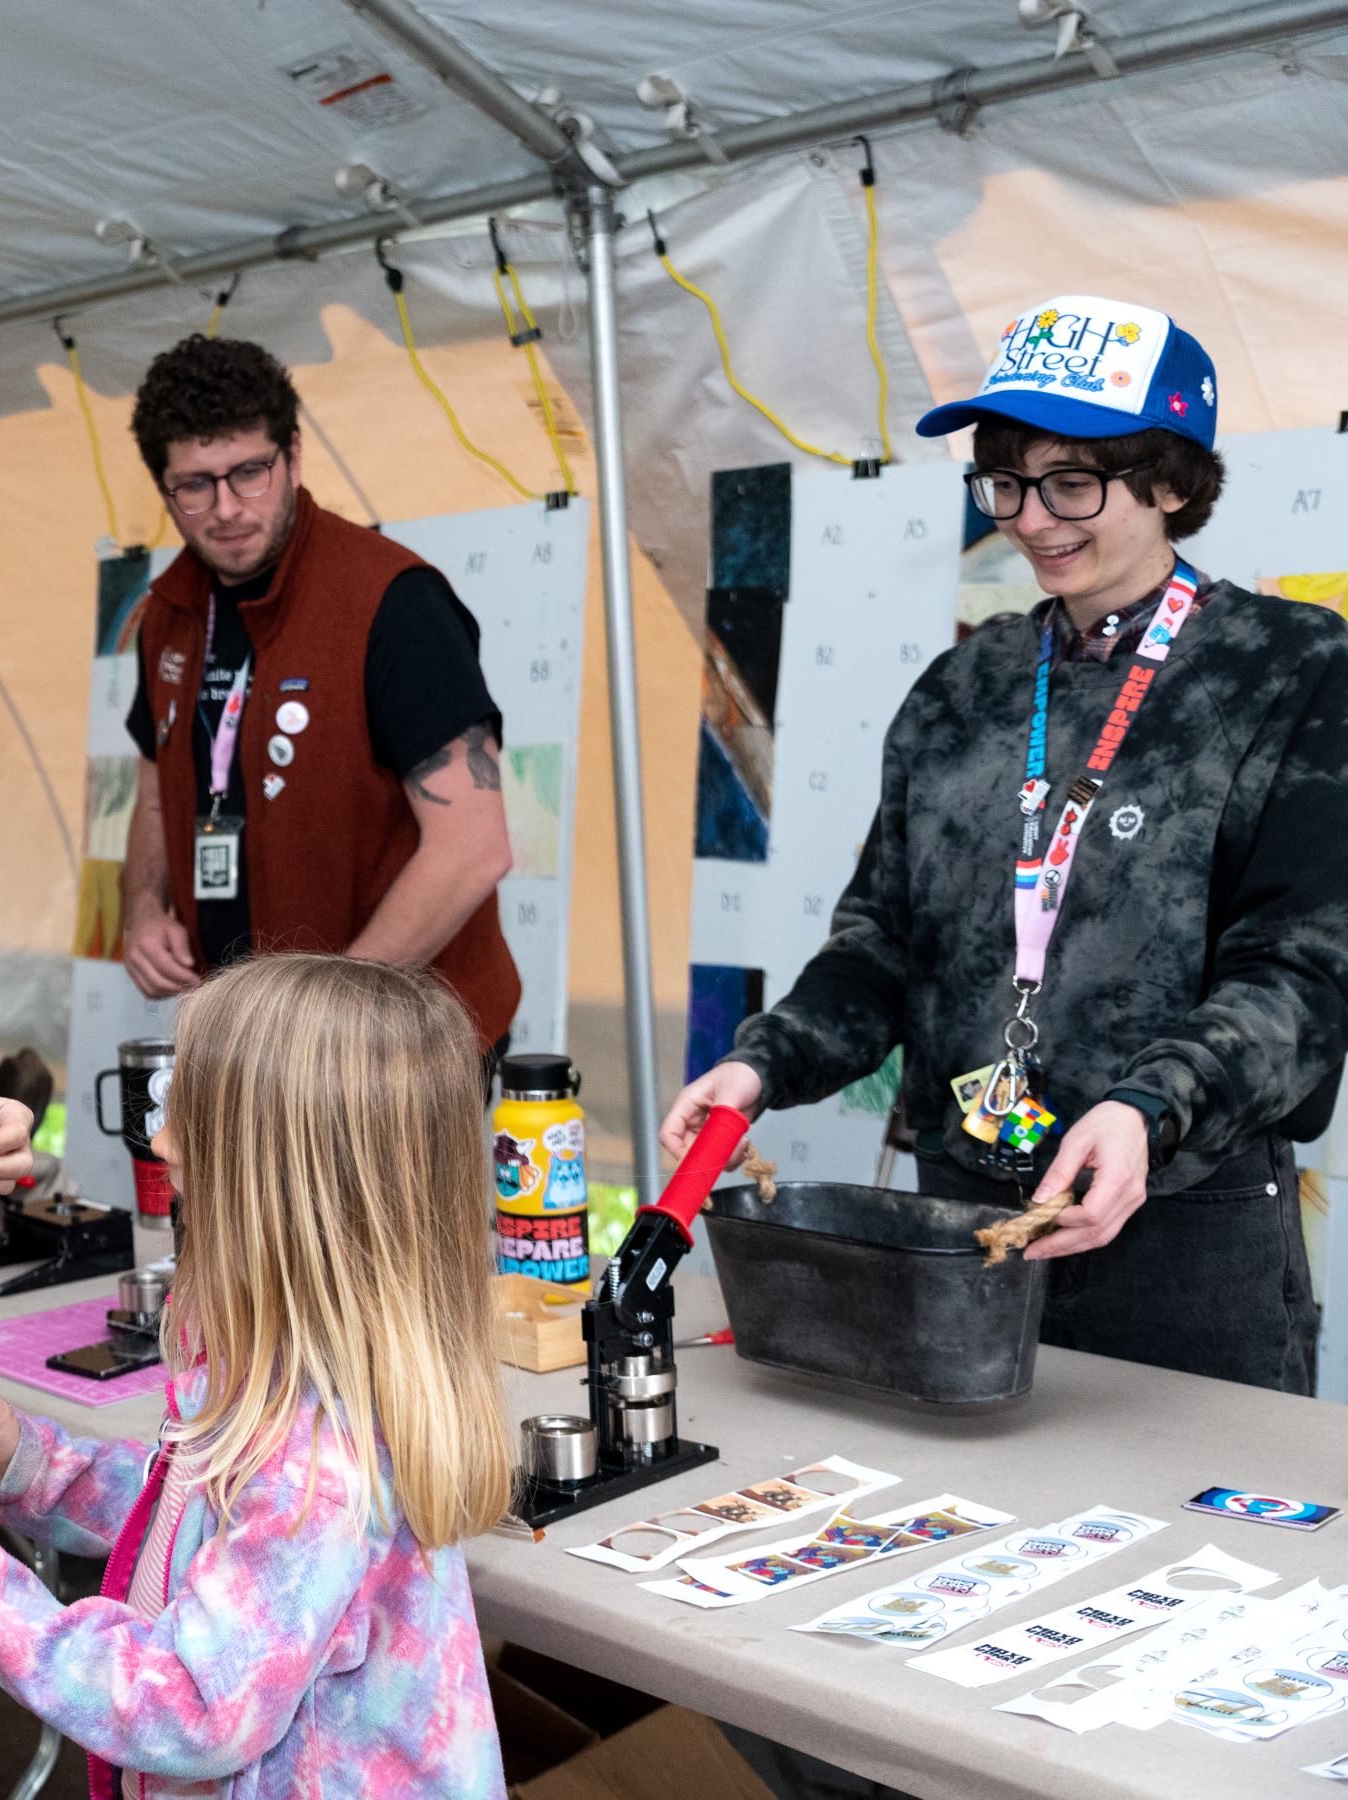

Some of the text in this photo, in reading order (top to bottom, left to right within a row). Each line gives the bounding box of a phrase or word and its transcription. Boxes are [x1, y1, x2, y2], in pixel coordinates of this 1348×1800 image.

[1001, 349, 1103, 378] Street
[1291, 488, 1322, 514] A7
[1086, 664, 1155, 772] INSPIRE
